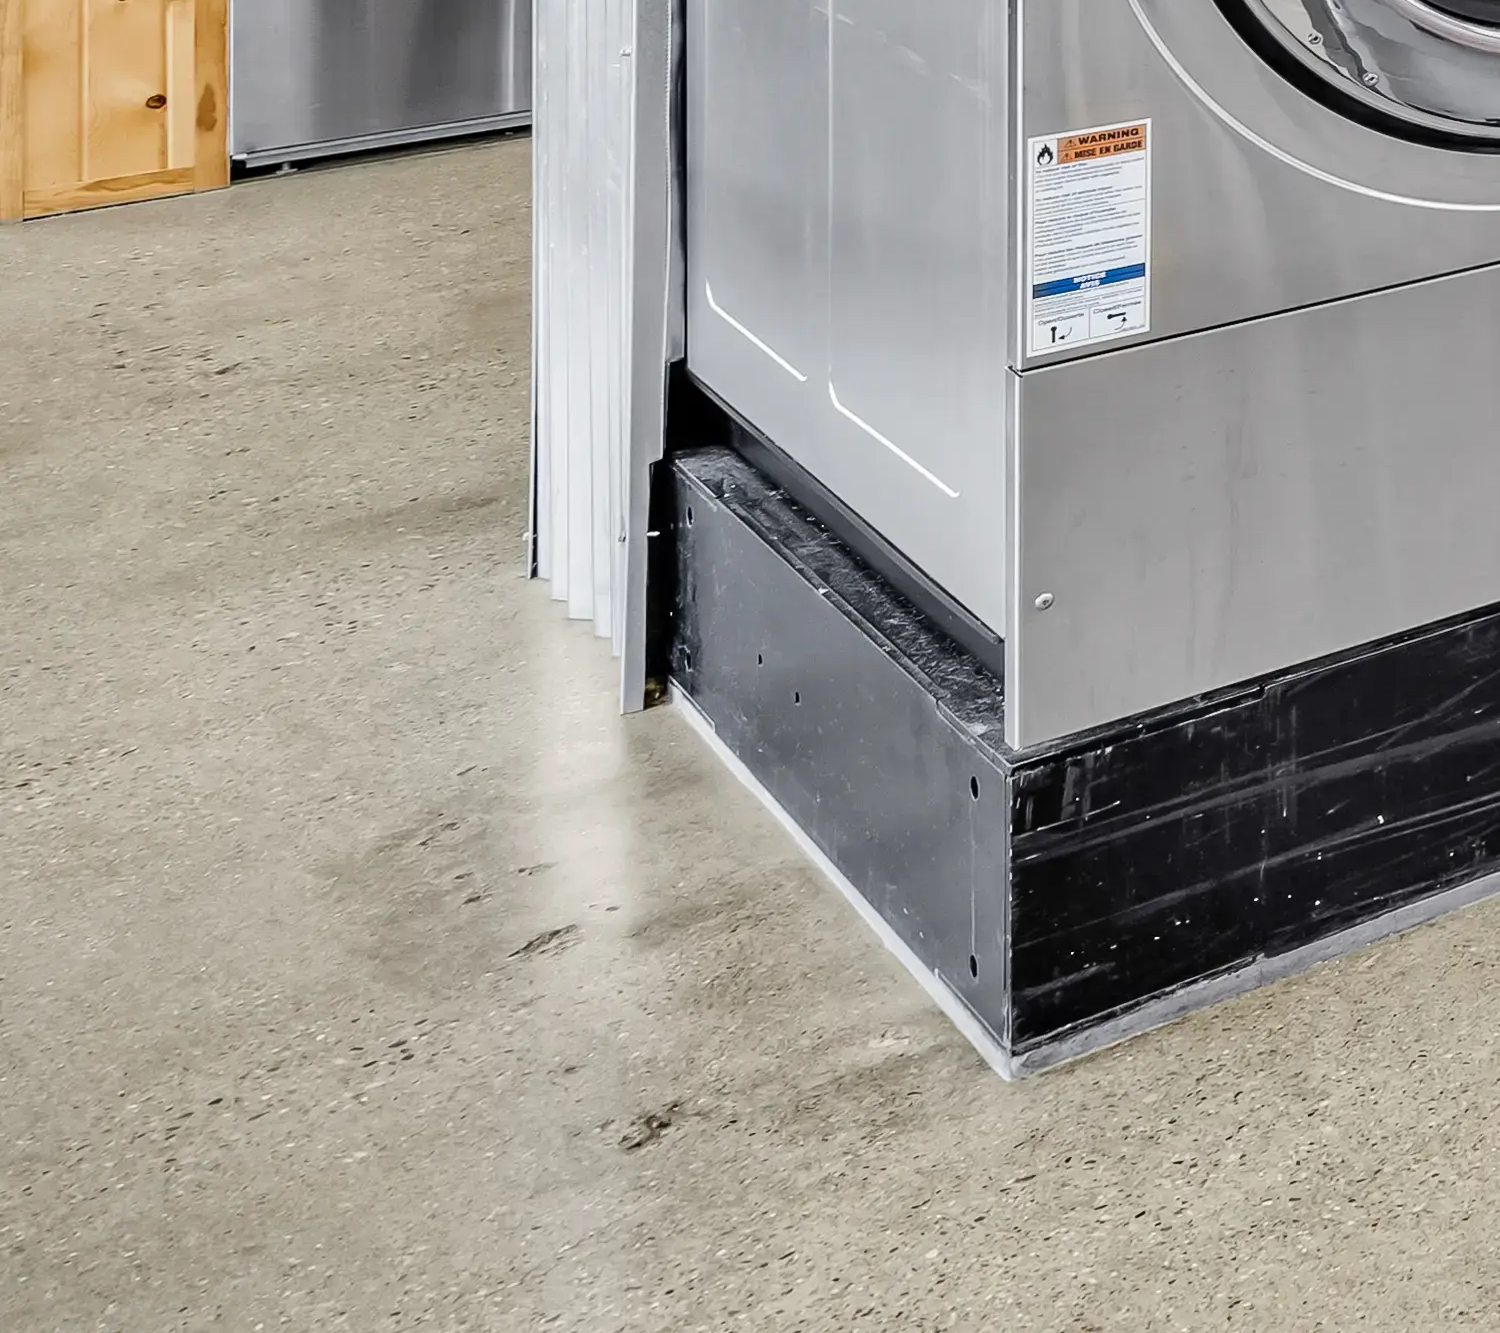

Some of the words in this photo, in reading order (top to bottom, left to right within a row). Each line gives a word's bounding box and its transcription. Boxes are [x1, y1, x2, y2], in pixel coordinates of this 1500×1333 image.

[1078, 127, 1140, 145] WARNING
[1074, 148, 1097, 159] MISE
[1099, 145, 1112, 154] EN
[1073, 271, 1107, 284] NOTICE
